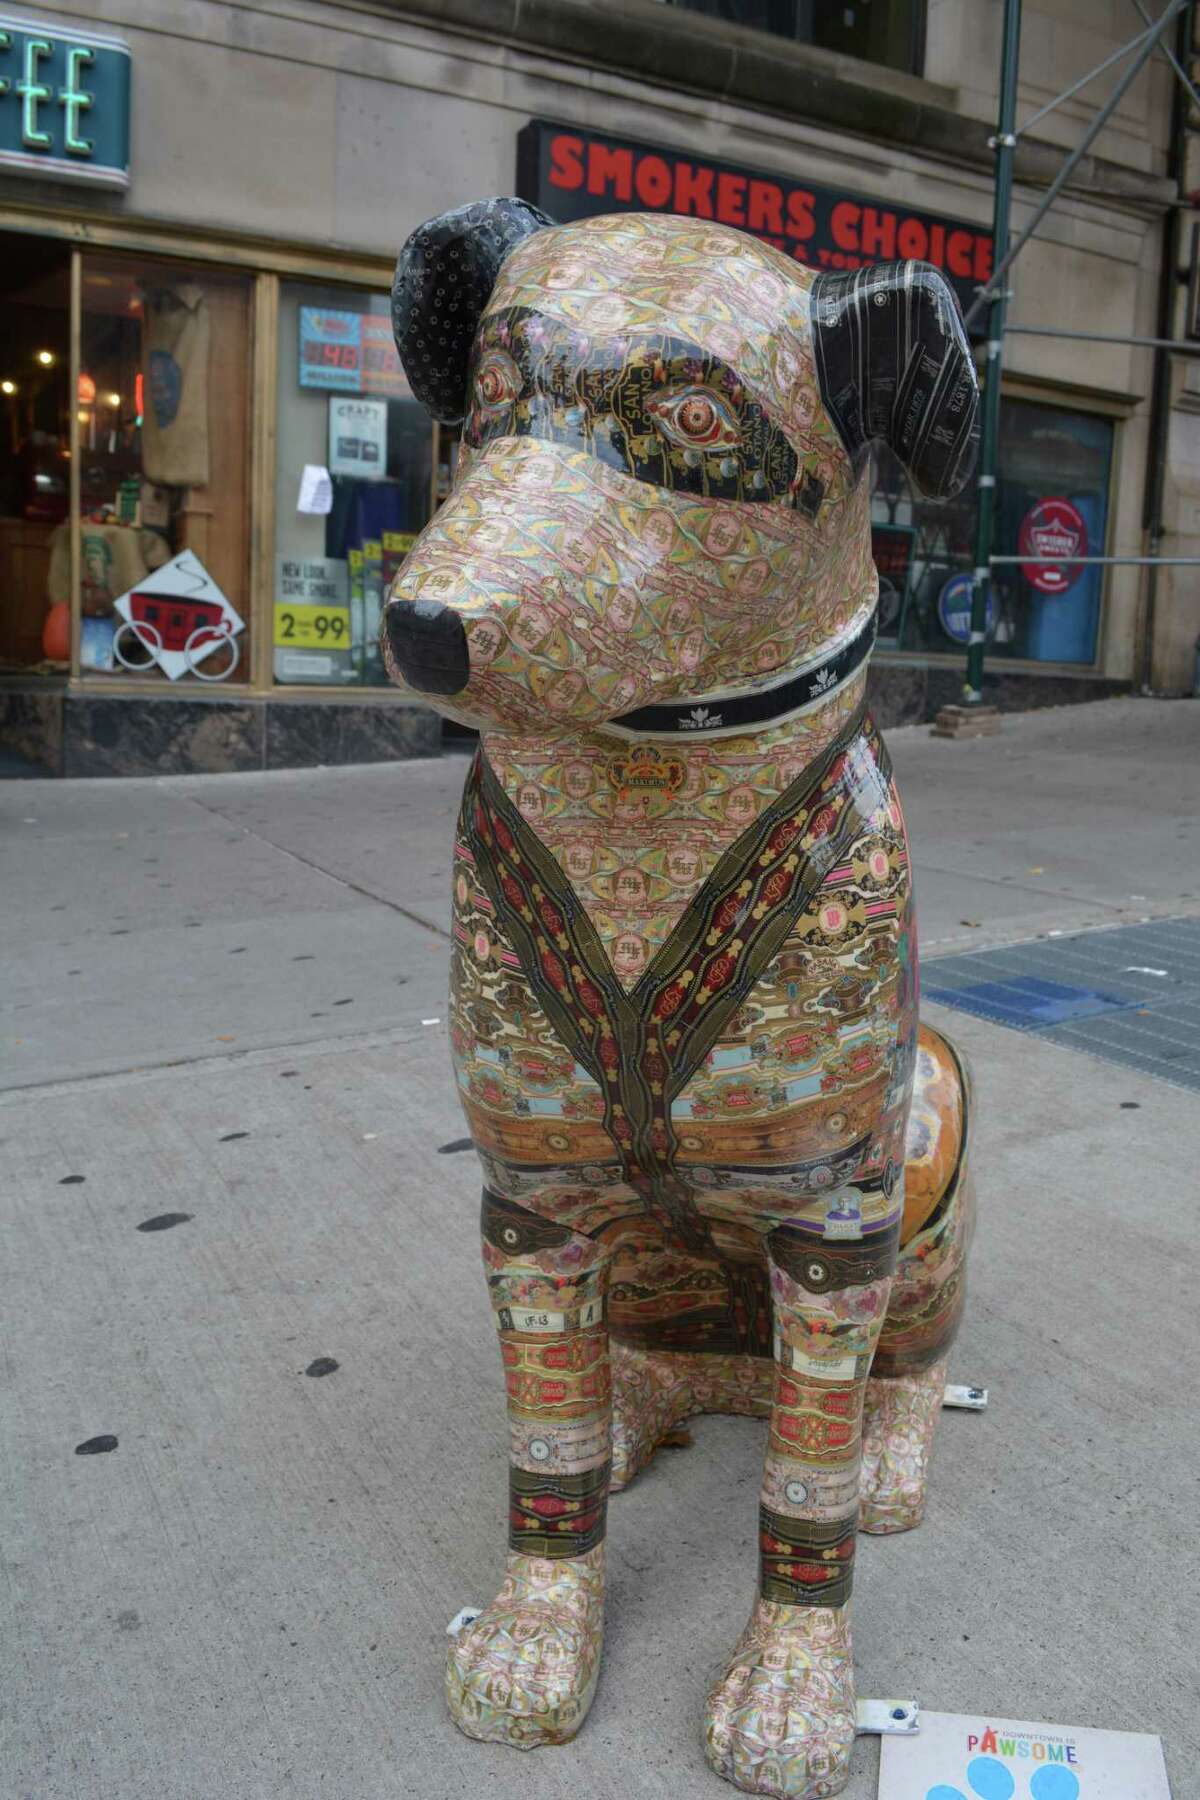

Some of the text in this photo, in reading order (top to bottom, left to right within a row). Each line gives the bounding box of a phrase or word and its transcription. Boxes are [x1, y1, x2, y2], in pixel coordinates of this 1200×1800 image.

[0, 30, 95, 154] EE
[548, 134, 993, 282] SMOKERS CHOICE
[624, 383, 641, 419] SAN
[742, 419, 754, 455] SAN
[771, 445, 784, 480] SAN
[281, 613, 296, 638] 2
[967, 1725, 1078, 1764] PAWSOME
[1003, 1731, 1062, 1745] DOWNTOWN
